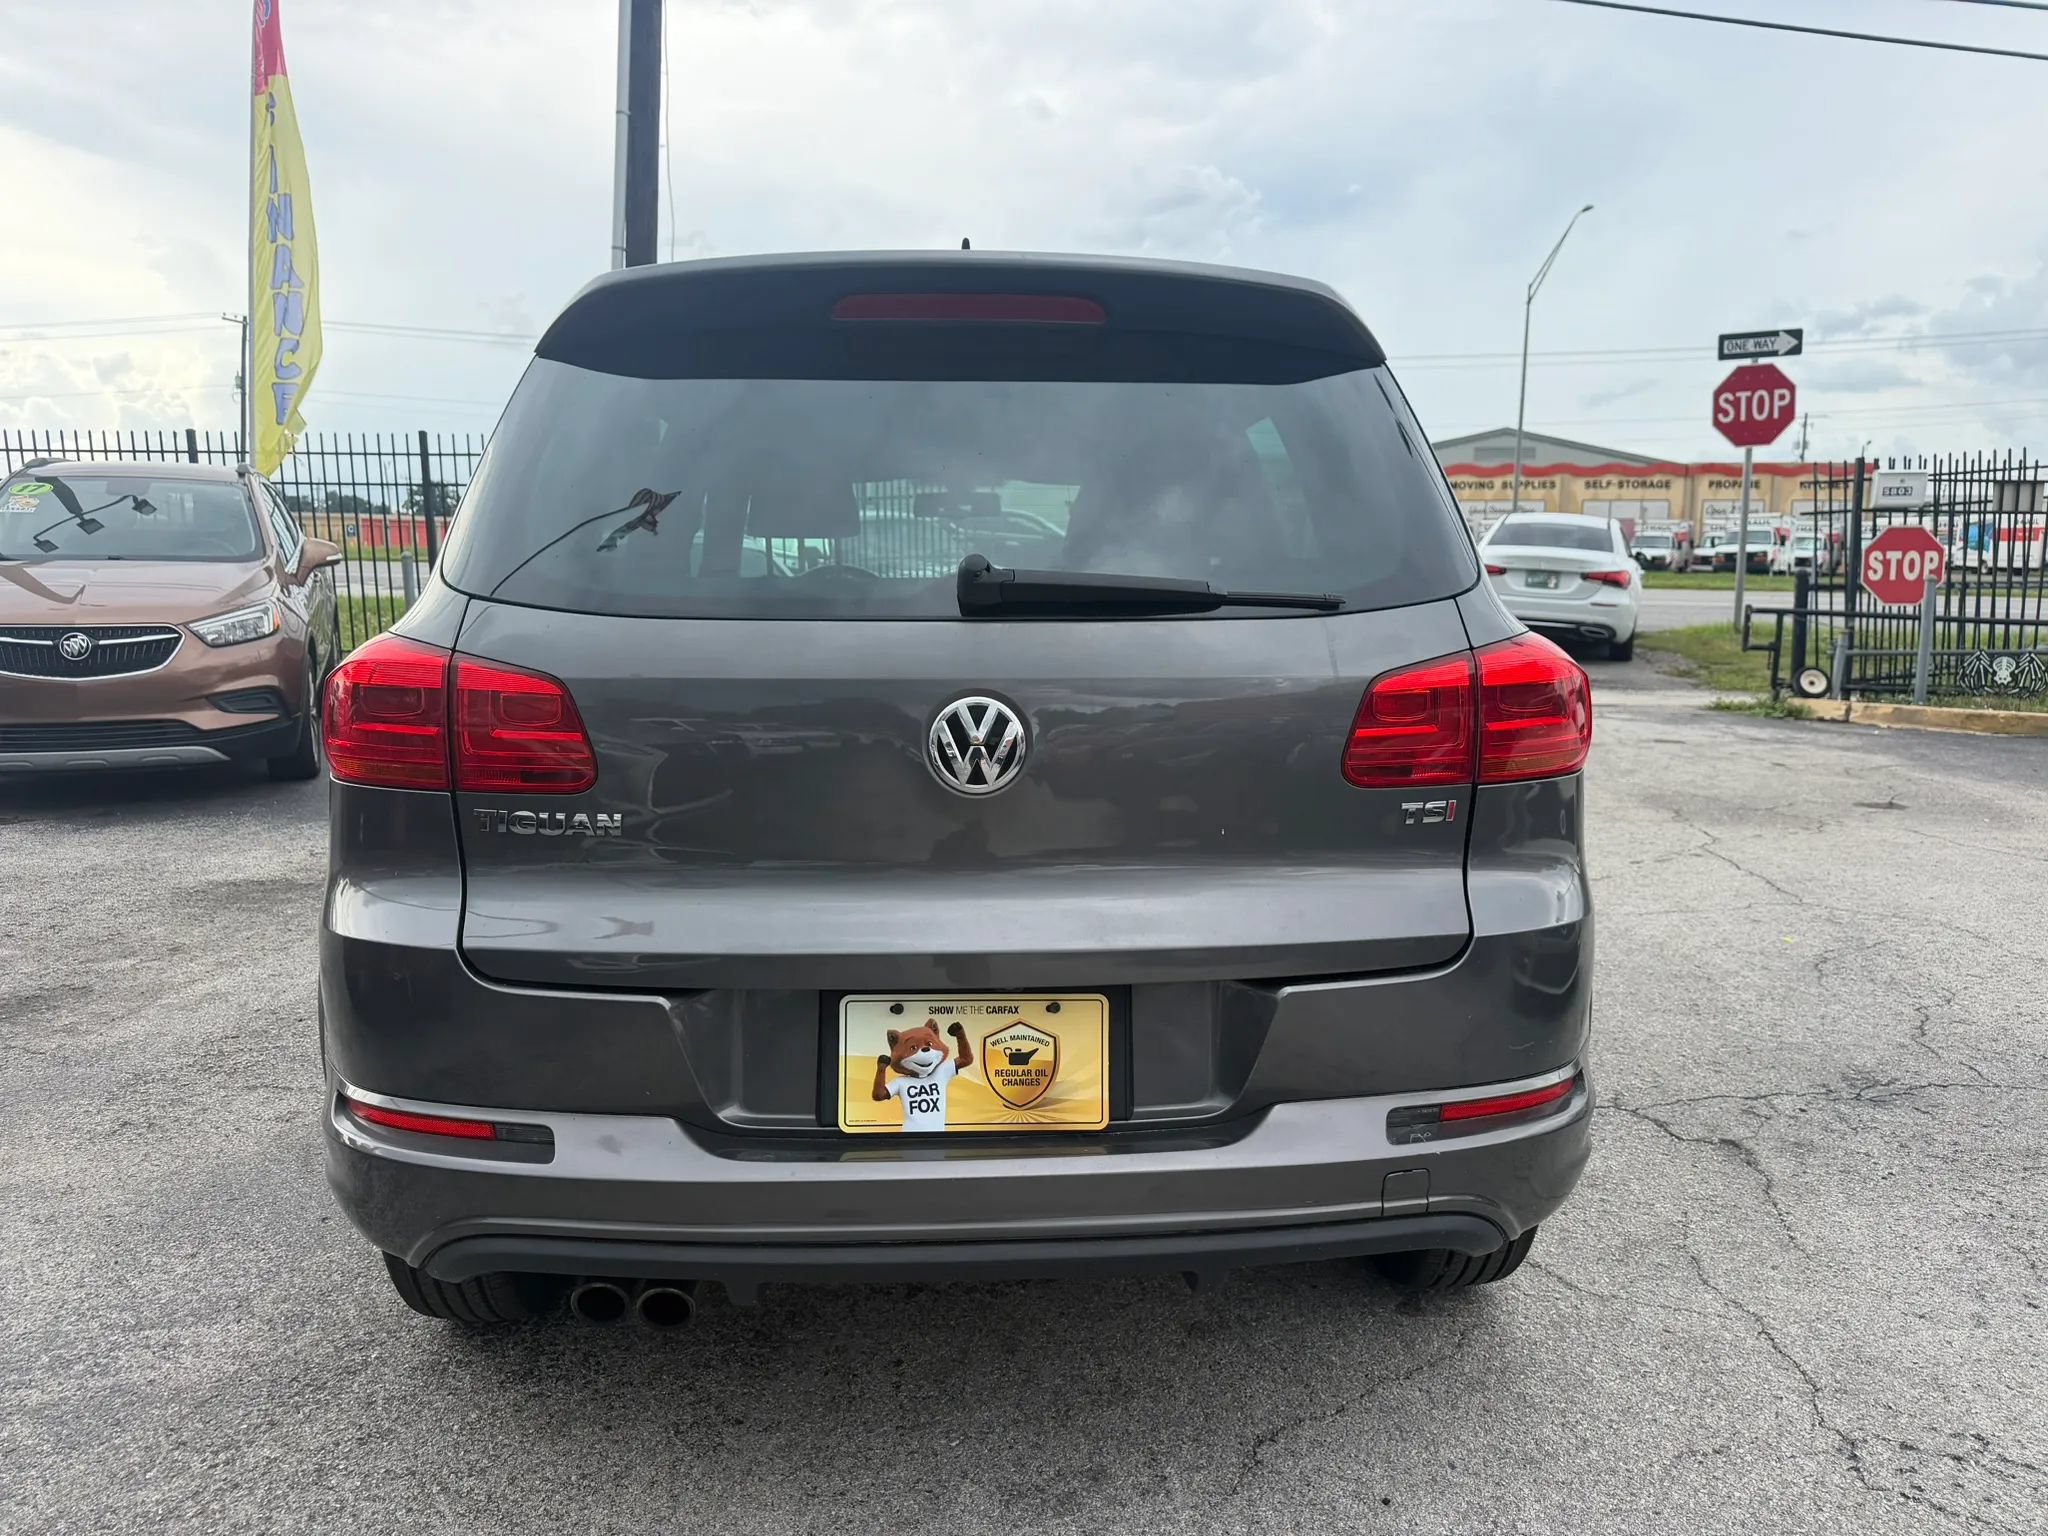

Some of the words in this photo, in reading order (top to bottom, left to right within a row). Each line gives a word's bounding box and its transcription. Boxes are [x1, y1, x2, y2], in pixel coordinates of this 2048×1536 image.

[1726, 339, 1748, 352] ONE
[1753, 338, 1776, 351] WAY
[1717, 388, 1791, 424] STOP
[1450, 480, 1495, 490] MOVING
[1584, 479, 1671, 490] SELF-STORAGE
[1867, 550, 1940, 581] STOP
[1401, 800, 1457, 824] TSI
[473, 808, 622, 836] TIGUAN
[928, 1006, 954, 1015] SHOW
[955, 1006, 969, 1014] ME
[970, 1006, 984, 1014] THE
[985, 1006, 1020, 1014] CARFAX
[990, 1035, 1009, 1047] WELL
[1009, 1034, 1050, 1047] MAINTAINED
[995, 1069, 1032, 1077] REGULAR
[1034, 1069, 1048, 1077] OIL
[1002, 1078, 1041, 1086] CHANGES
[906, 1082, 940, 1098] CAR
[908, 1098, 940, 1115] FOX
